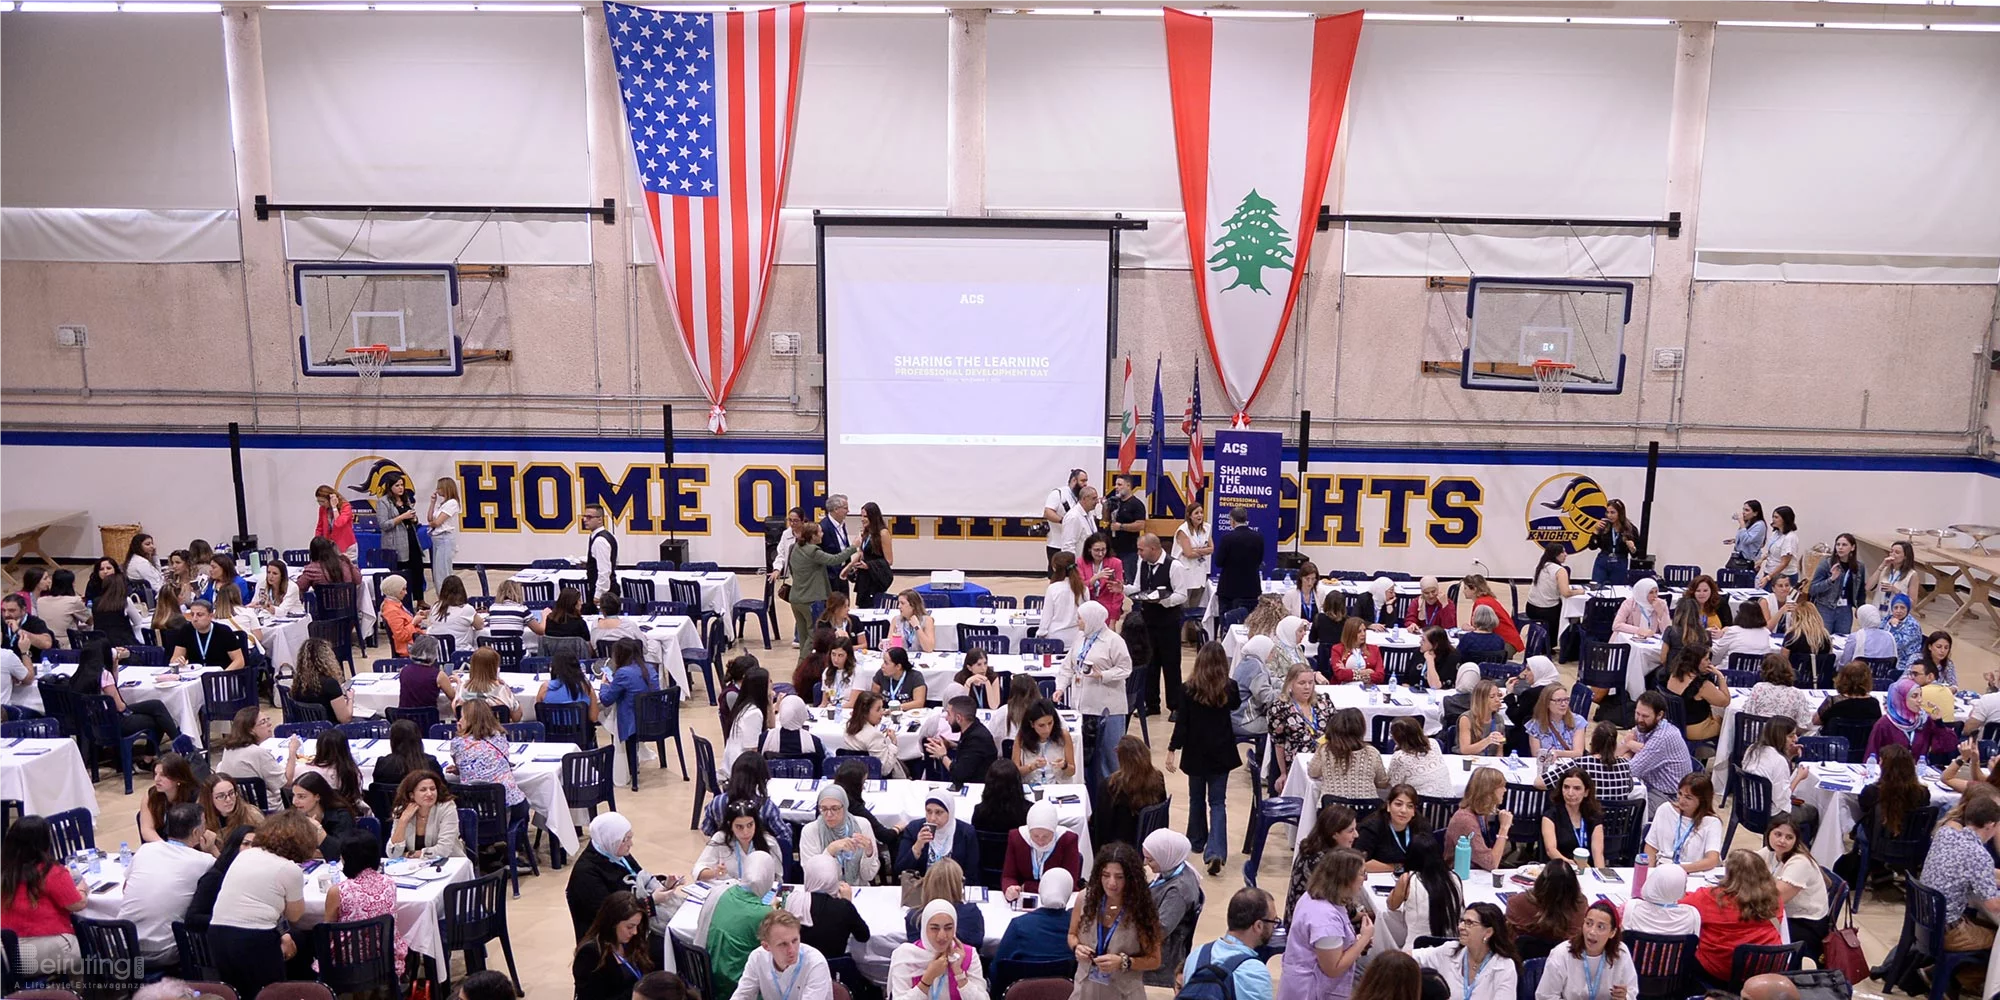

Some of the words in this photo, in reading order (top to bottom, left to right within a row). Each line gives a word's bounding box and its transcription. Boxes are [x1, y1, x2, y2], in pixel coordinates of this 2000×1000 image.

[960, 294, 984, 304] ACS
[894, 356, 952, 367] SHARING
[956, 356, 980, 367] THE
[984, 356, 1050, 368] LEARNING
[895, 368, 963, 376] PROFESSIONAL
[965, 368, 1029, 377] DEVELOPMENT
[1030, 369, 1048, 377] DAY
[1222, 443, 1248, 454] ACS
[1220, 465, 1267, 476] SHARING
[1220, 475, 1240, 484] THE
[1220, 484, 1272, 496] LEARNING
[455, 461, 711, 536] HOME
[1526, 532, 1580, 540] KNIGHTS
